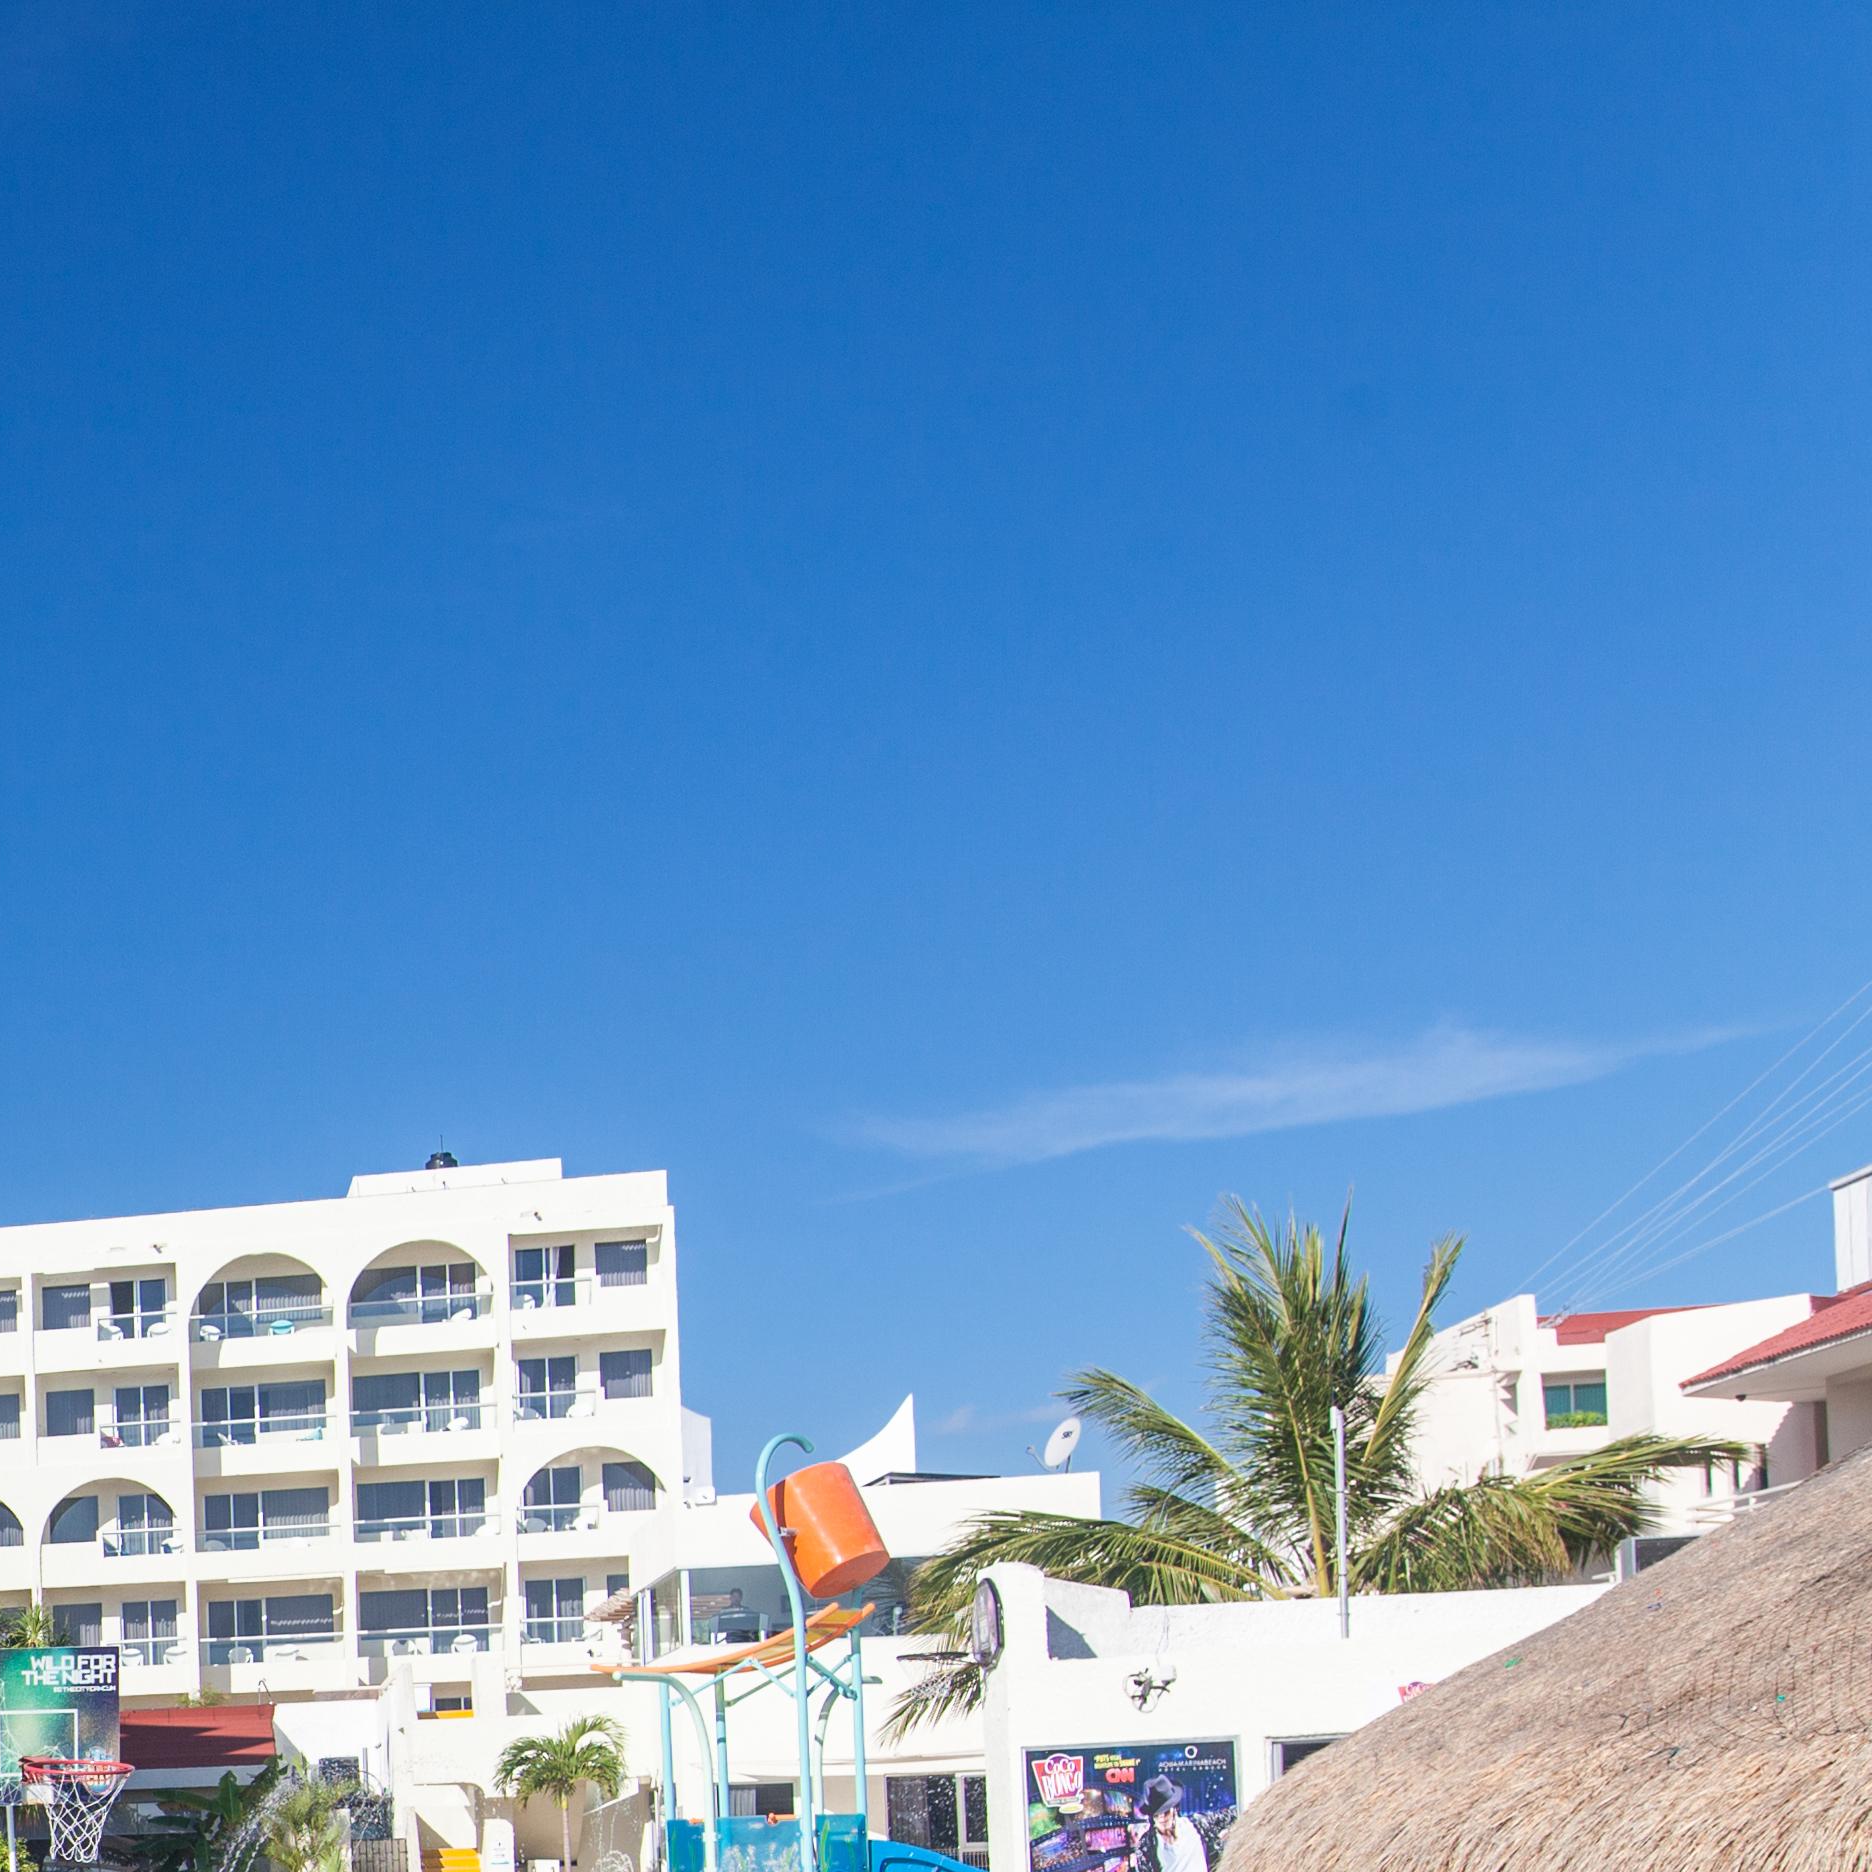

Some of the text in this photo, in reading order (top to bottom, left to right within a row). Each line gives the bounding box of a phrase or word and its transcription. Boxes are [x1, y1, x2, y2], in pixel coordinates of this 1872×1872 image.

[77, 1654, 116, 1670] FOR
[21, 1669, 116, 1685] THE NIGHT
[1105, 1767, 1135, 1784] CNN
